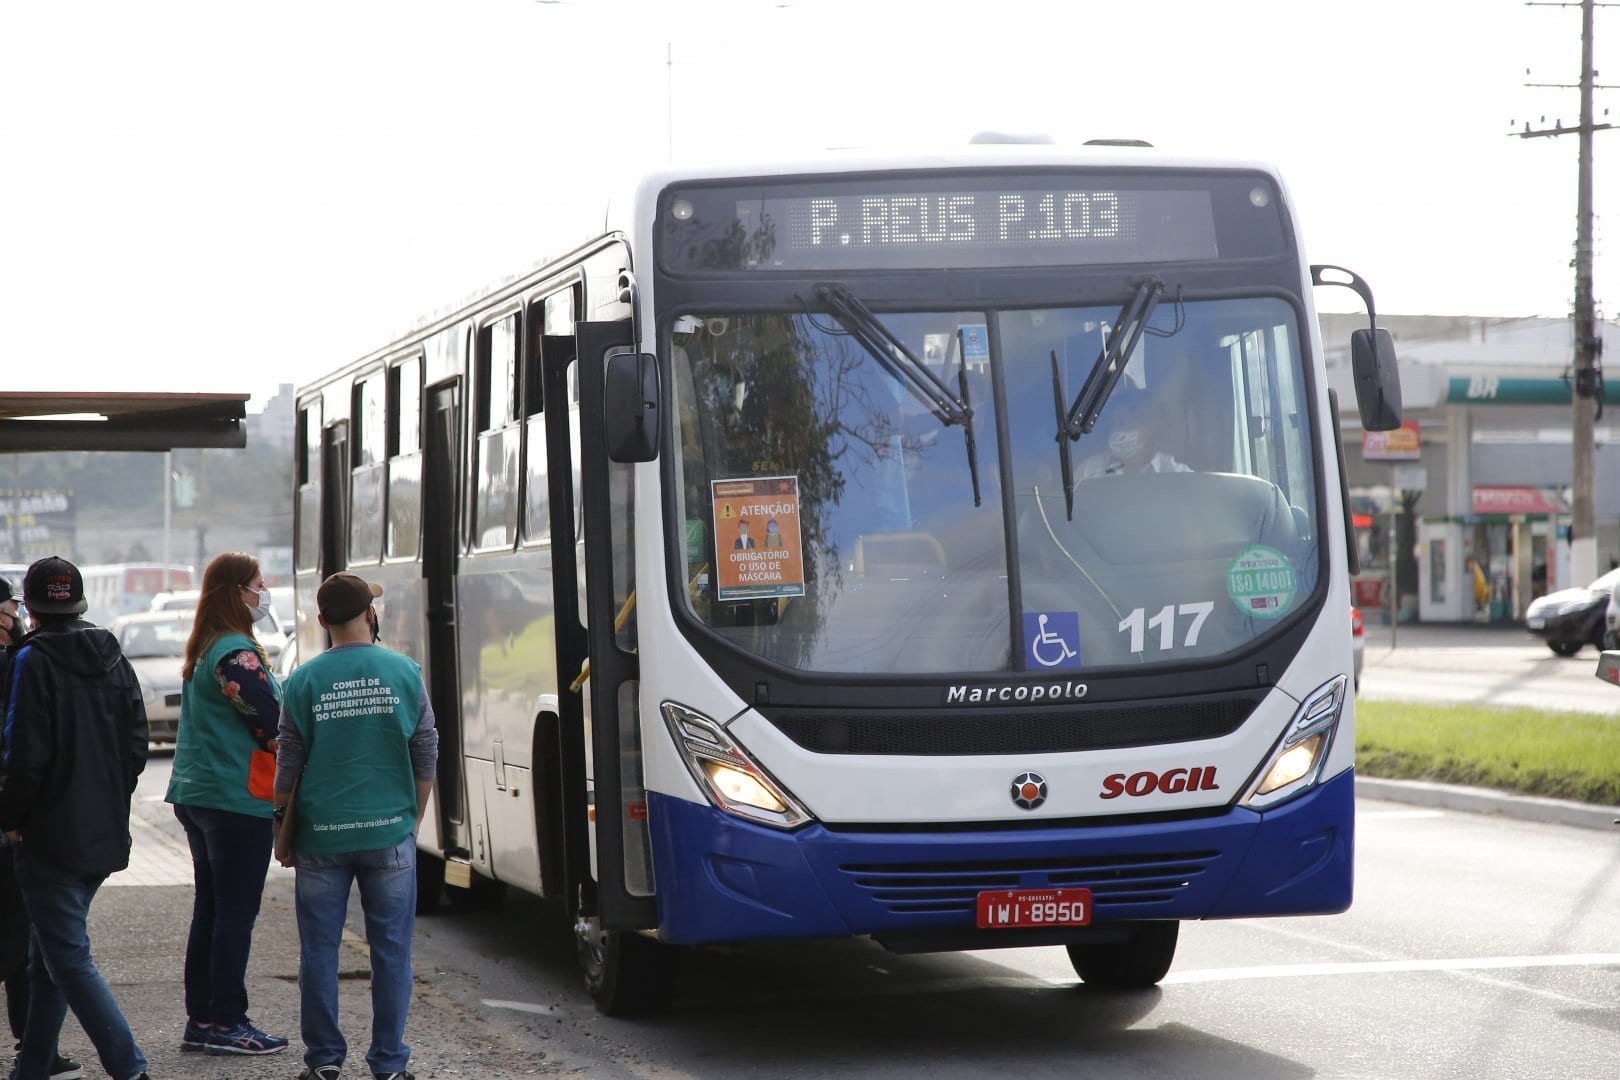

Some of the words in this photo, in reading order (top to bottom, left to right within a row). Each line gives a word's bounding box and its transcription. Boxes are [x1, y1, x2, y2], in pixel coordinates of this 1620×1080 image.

[1000, 192, 1118, 239] P.103
[740, 501, 795, 518] ATENÇÃO!
[730, 549, 789, 562] OBRIGATÓRIO
[739, 564, 746, 572] O
[748, 562, 767, 572] USO
[769, 561, 782, 570] DE
[738, 571, 782, 582] MÁSCARA
[1231, 573, 1253, 593] ISO
[1255, 569, 1293, 592] 14001
[1118, 601, 1215, 653] 117
[332, 677, 367, 690] COMITÊ
[367, 678, 380, 686] DE
[320, 687, 391, 702] SOLIDARIEDADE
[946, 681, 1088, 703] Marcopolo
[323, 696, 400, 711] ENFRENTAMENTO
[315, 713, 329, 721] DO
[331, 705, 394, 719] CORONAVÍRUS
[1099, 766, 1220, 800] SOGIL
